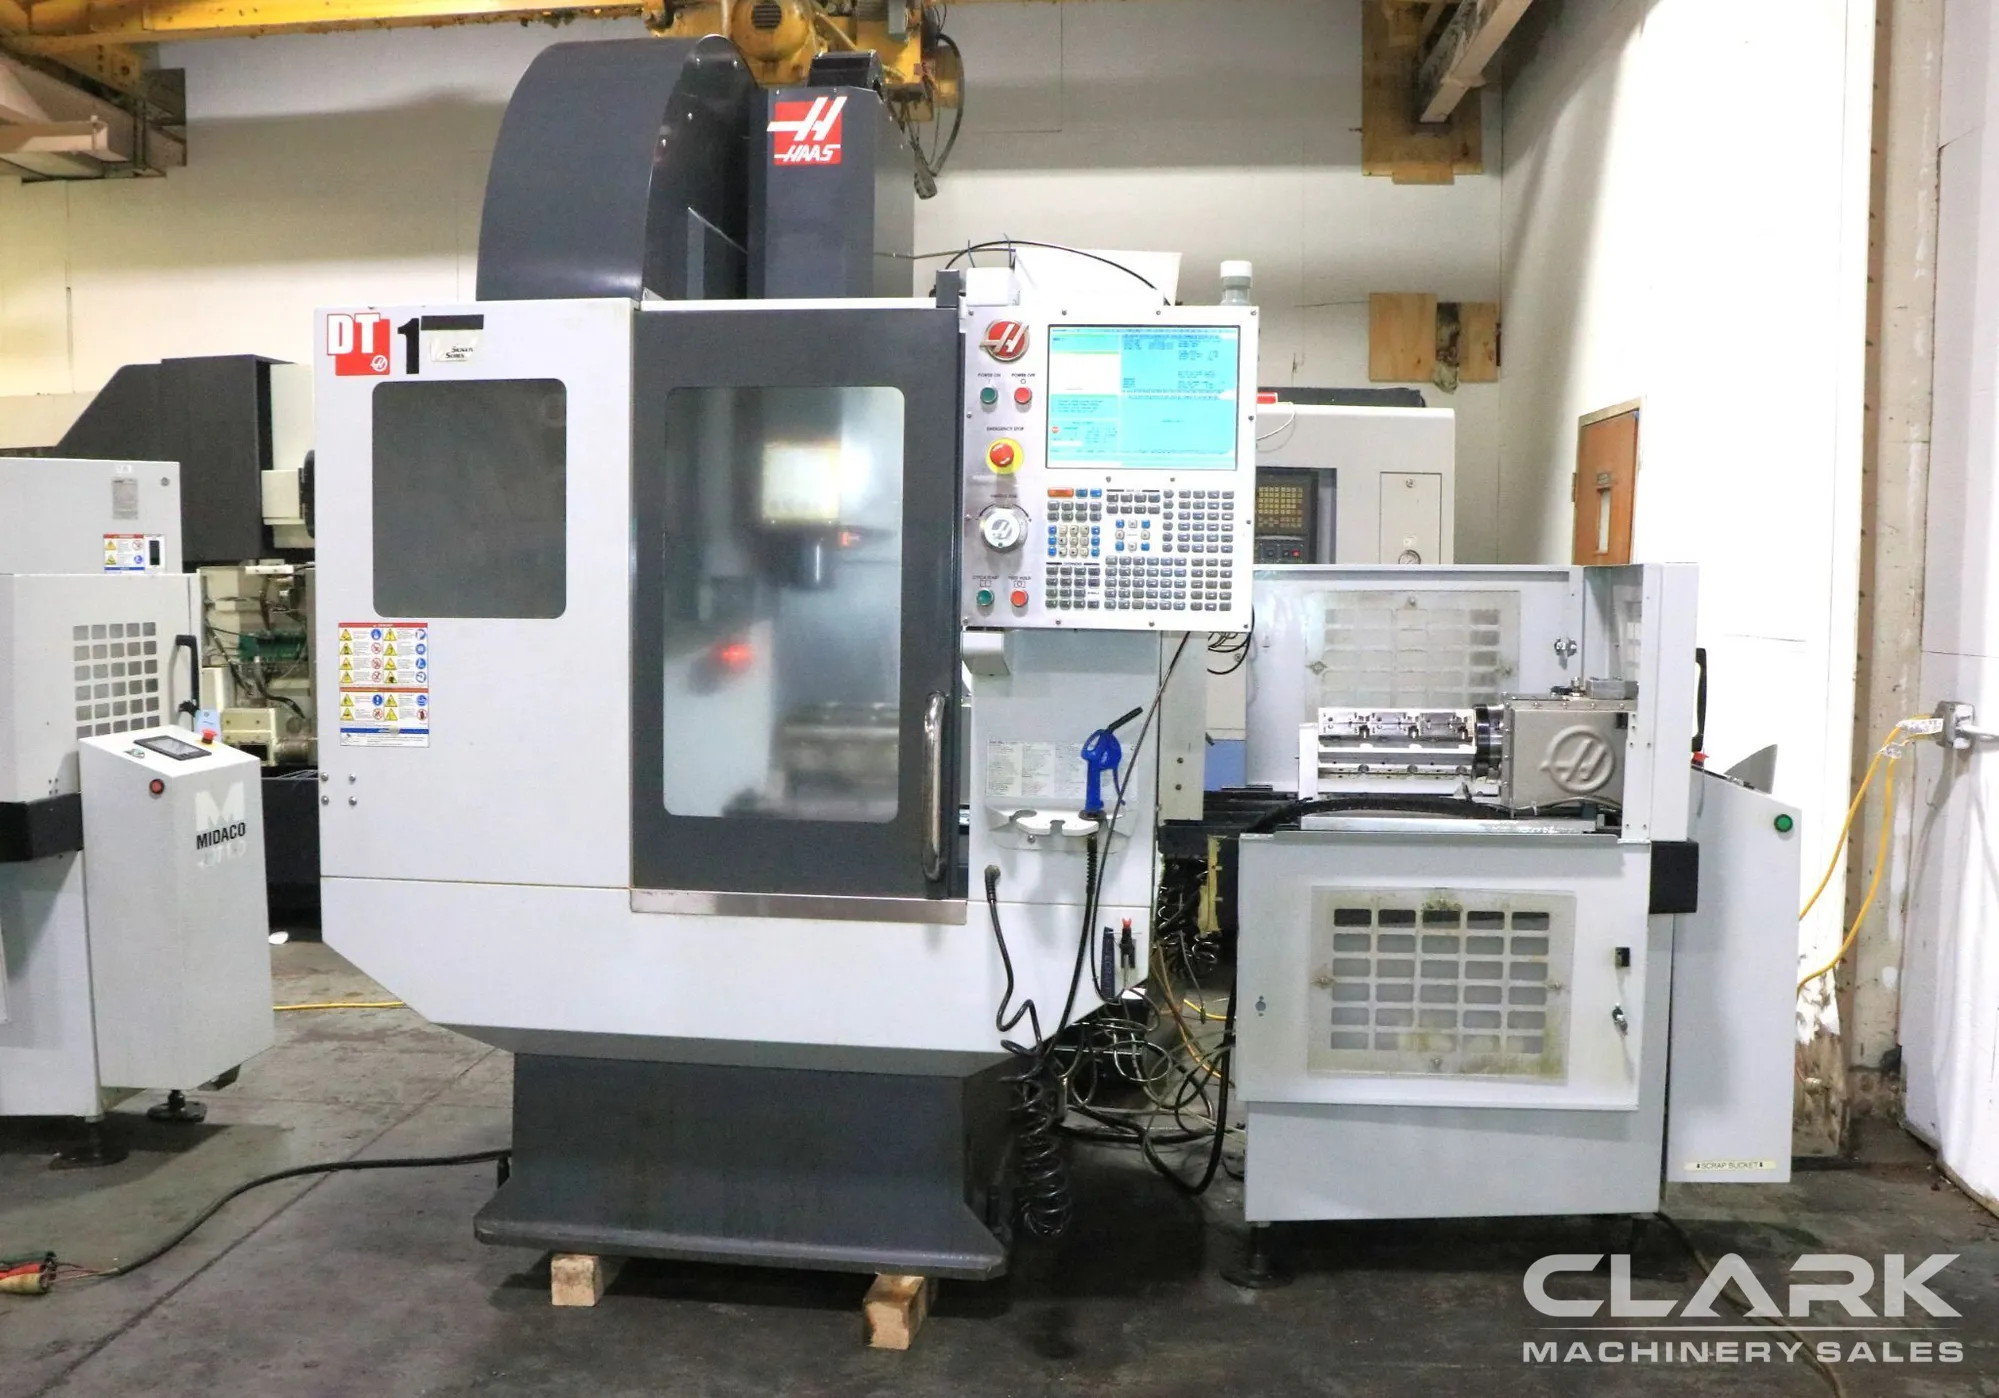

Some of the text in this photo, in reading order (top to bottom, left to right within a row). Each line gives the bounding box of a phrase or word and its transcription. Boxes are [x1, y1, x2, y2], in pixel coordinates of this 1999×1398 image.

[774, 144, 841, 162] HAAS
[327, 312, 420, 375] DT 1
[196, 821, 246, 850] MIDACO
